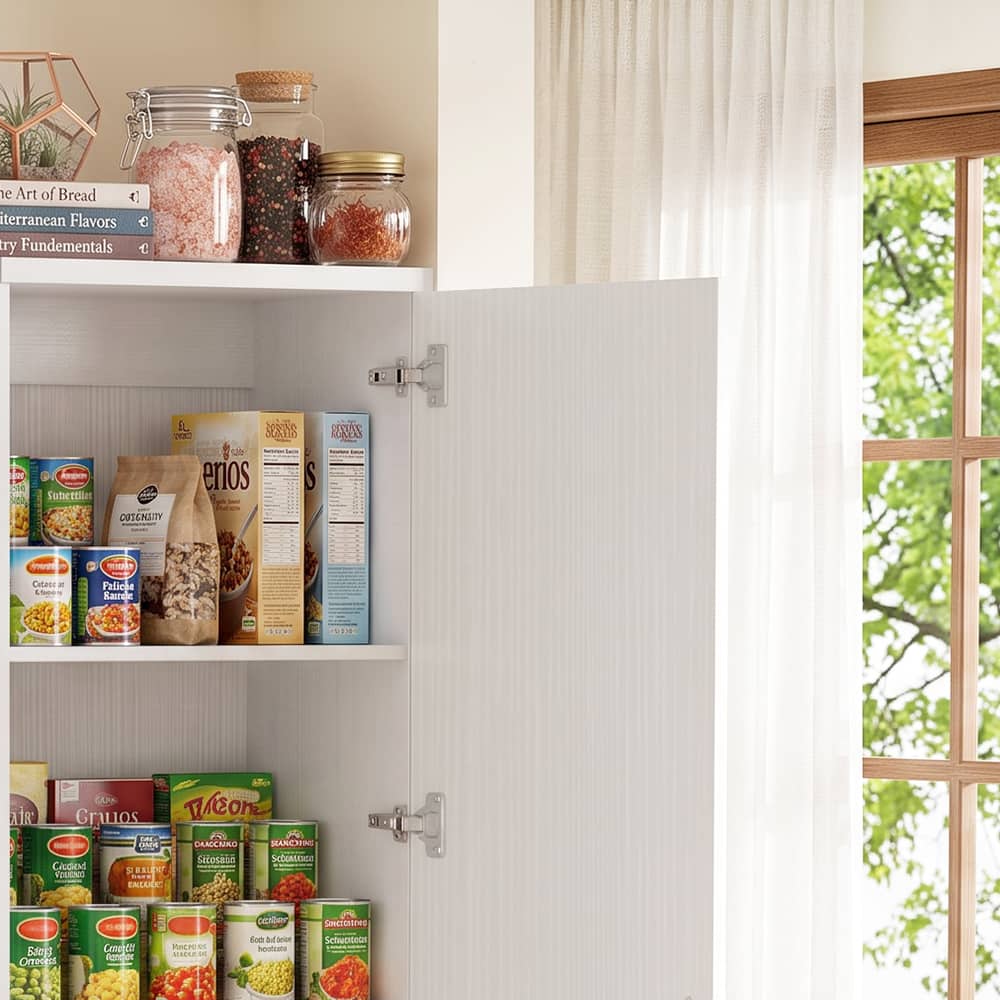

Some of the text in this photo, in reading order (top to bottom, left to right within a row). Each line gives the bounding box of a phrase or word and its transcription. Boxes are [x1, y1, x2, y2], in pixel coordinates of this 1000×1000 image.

[16, 186, 38, 201] Art
[41, 186, 56, 201] of
[59, 187, 97, 202] Bread
[70, 212, 117, 229] Flavors
